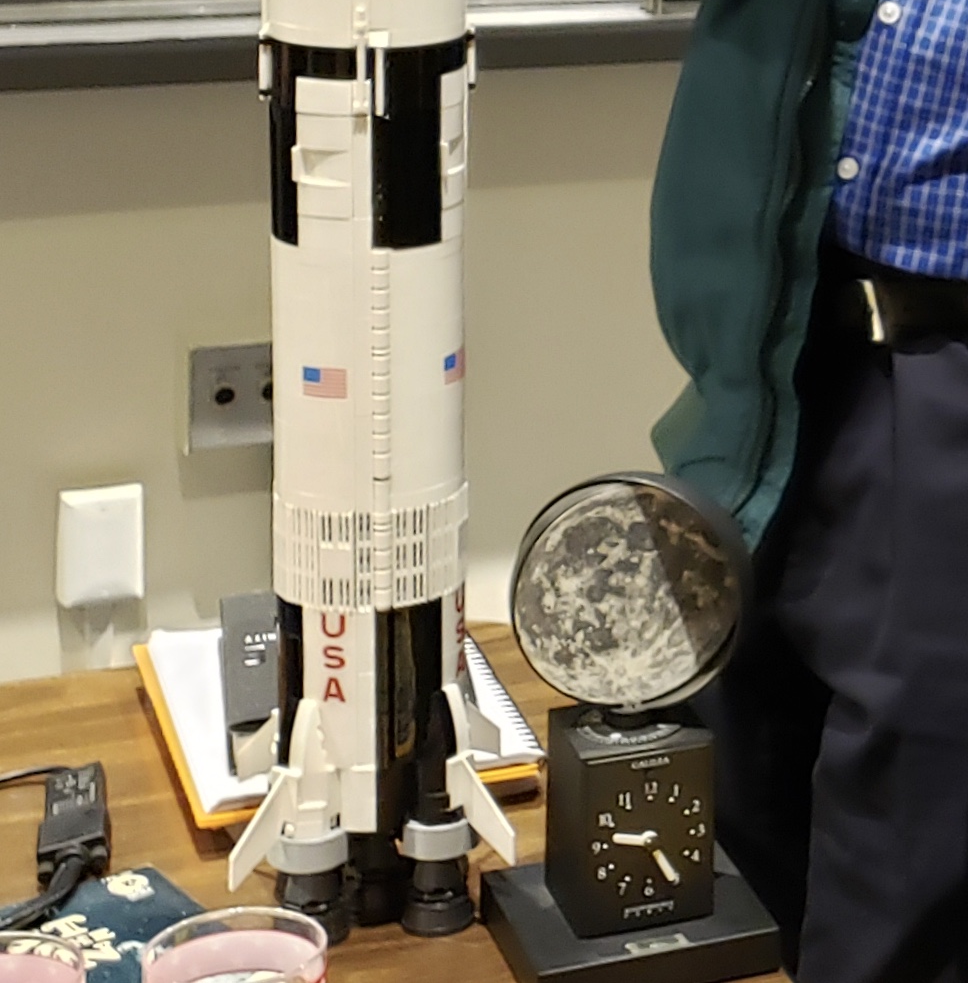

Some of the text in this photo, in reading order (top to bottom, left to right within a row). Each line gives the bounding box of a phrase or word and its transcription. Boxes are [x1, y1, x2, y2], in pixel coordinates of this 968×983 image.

[321, 612, 346, 703] USA
[691, 799, 701, 813] 2
[697, 822, 706, 837] 3
[591, 841, 601, 855] 9
[690, 849, 700, 862] 4
[597, 866, 607, 880] 8
[618, 881, 627, 896] 7
[644, 884, 655, 897] 6
